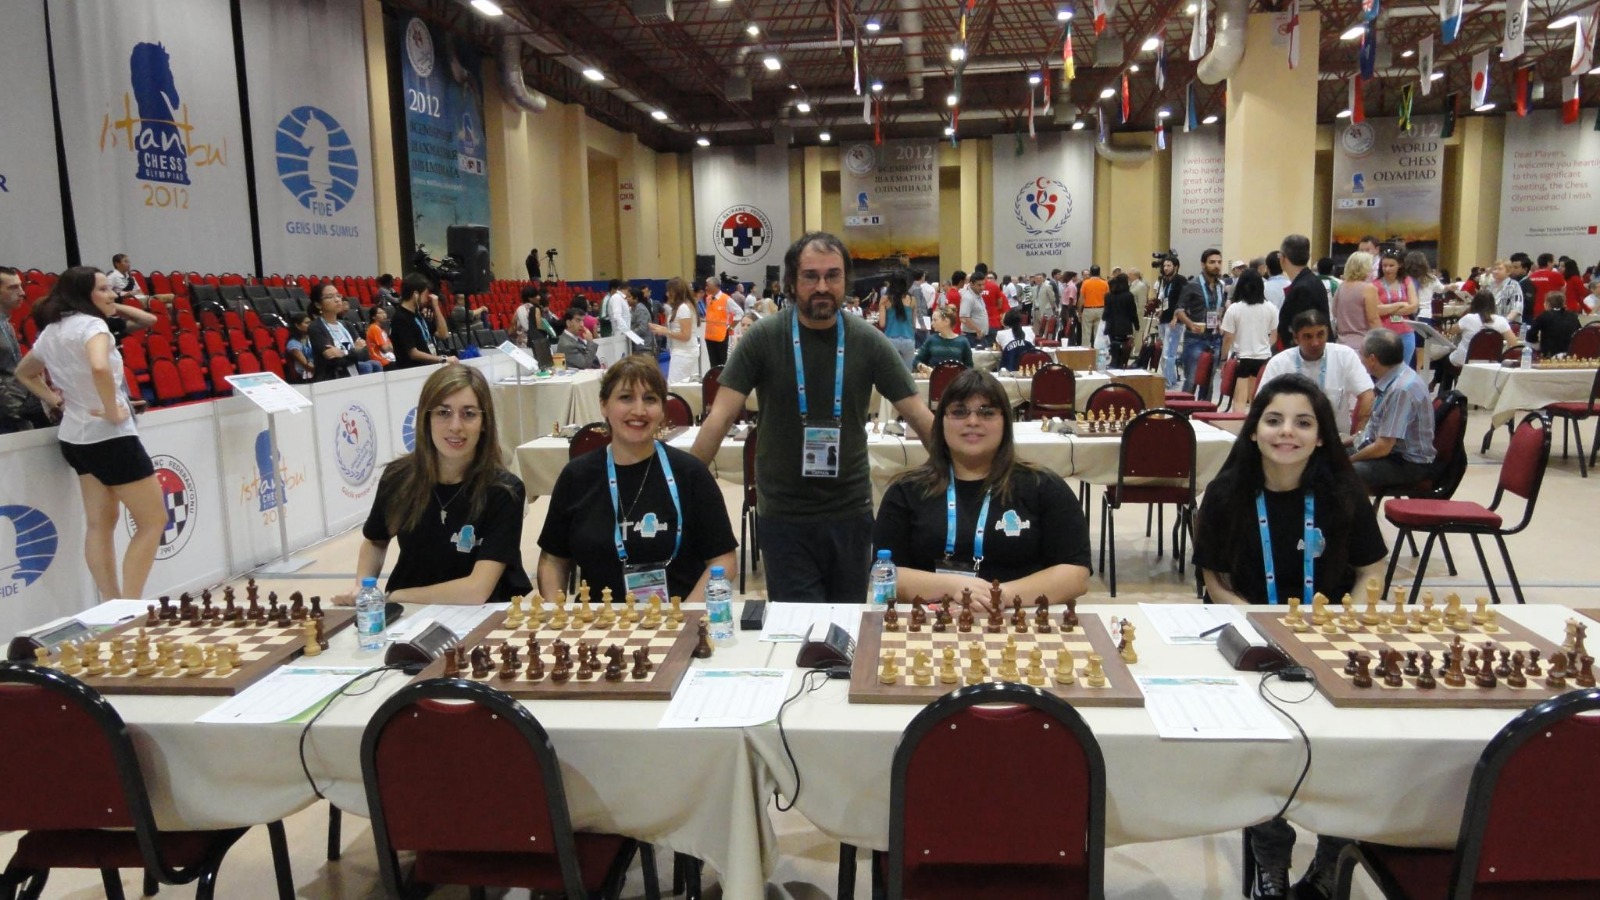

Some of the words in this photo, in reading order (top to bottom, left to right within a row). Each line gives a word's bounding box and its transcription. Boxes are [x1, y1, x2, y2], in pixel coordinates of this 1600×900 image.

[408, 88, 441, 118] 2012
[895, 145, 933, 160] 2012
[1391, 142, 1438, 154] WORLD
[144, 152, 183, 172] CHESS
[1399, 156, 1437, 167] CHESS
[1518, 161, 1555, 169] welcome
[1556, 162, 1572, 170] you
[145, 168, 184, 181] OLYMPIAD
[1183, 167, 1199, 175] who
[1373, 170, 1437, 181] OLYMPIAD
[1522, 172, 1538, 180] this
[1540, 170, 1581, 181] significant
[875, 175, 933, 184] ШАХМАТНАЯ
[1183, 177, 1202, 186] great
[1564, 181, 1588, 189] Chess
[875, 185, 933, 194] ОЛИМПИАДА
[1183, 187, 1201, 195] sport
[142, 183, 189, 209] 2012
[1511, 193, 1550, 203] Olympiad
[1551, 192, 1567, 200] and
[1573, 191, 1591, 199] wish
[312, 201, 333, 217] FIDE
[1183, 207, 1210, 215] country
[1511, 206, 1525, 214] you
[1182, 217, 1209, 225] respect
[286, 221, 311, 235] GENS
[1006, 340, 1025, 351] INDIA
[169, 461, 196, 514] FEDERASYONU
